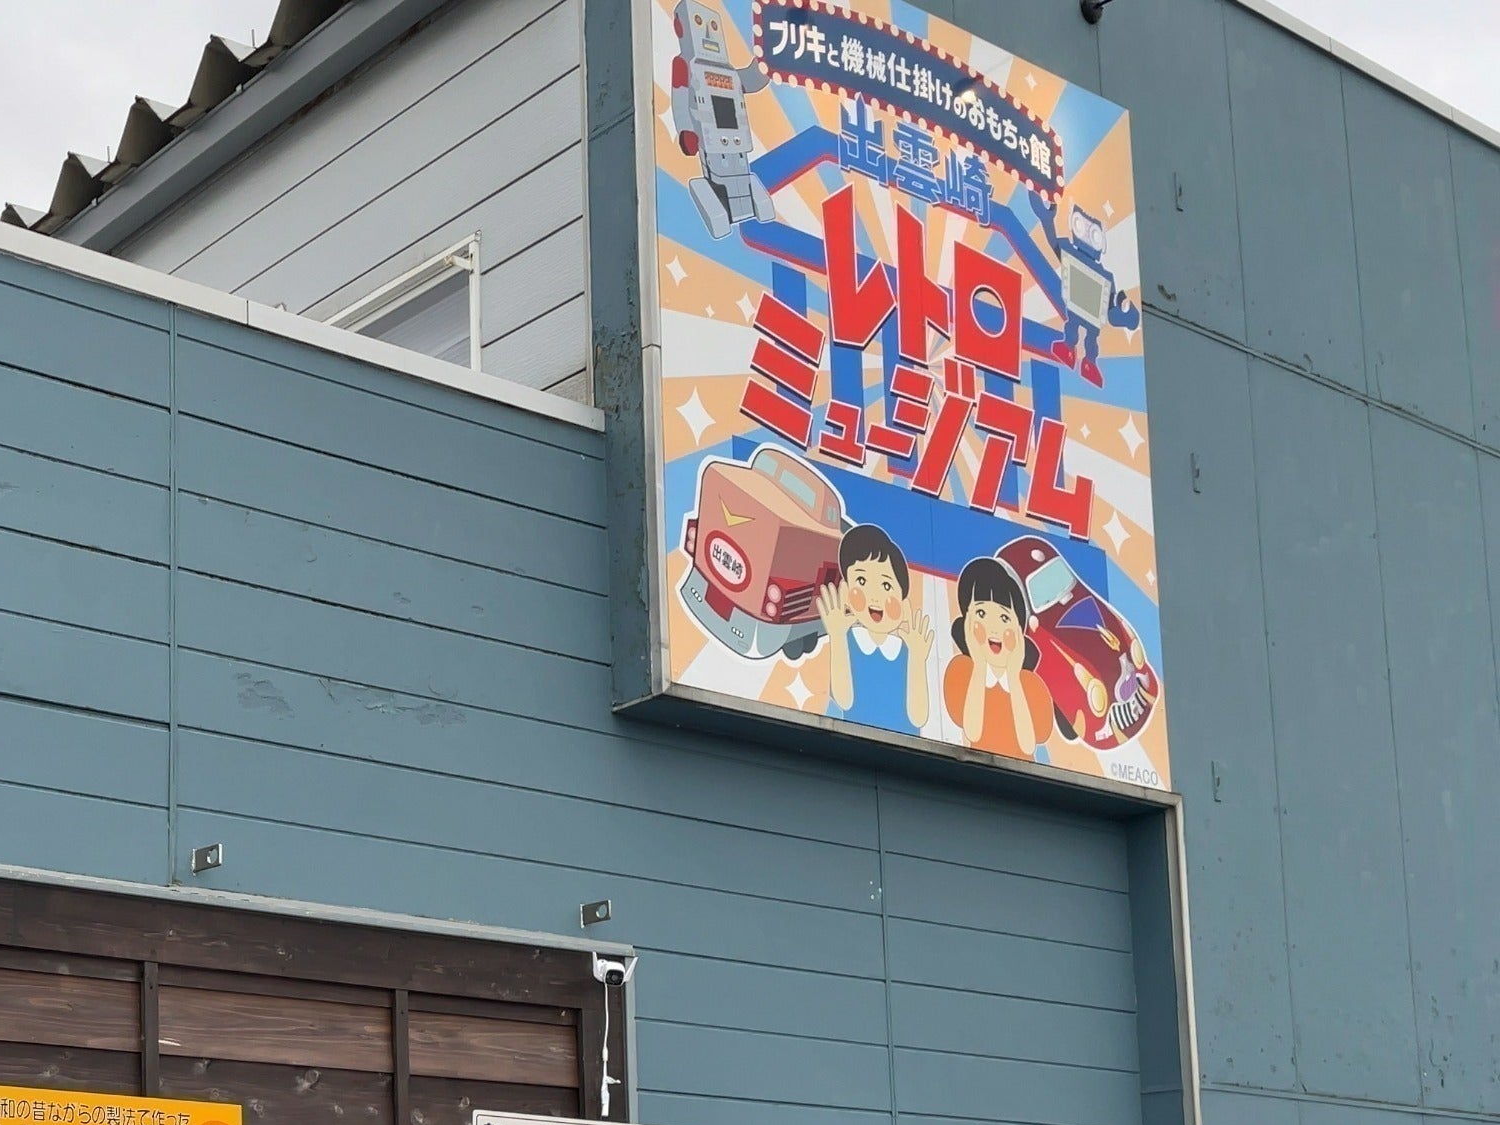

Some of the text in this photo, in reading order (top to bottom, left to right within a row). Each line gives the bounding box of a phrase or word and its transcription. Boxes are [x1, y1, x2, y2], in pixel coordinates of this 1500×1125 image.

[769, 19, 1052, 180] ブリキと機械仕掛けのおもちゃ館
[839, 94, 993, 227] 出雲崎
[821, 182, 1024, 381] レトロ
[740, 290, 1095, 542] ミュージアム
[712, 542, 745, 582] 出雲崎
